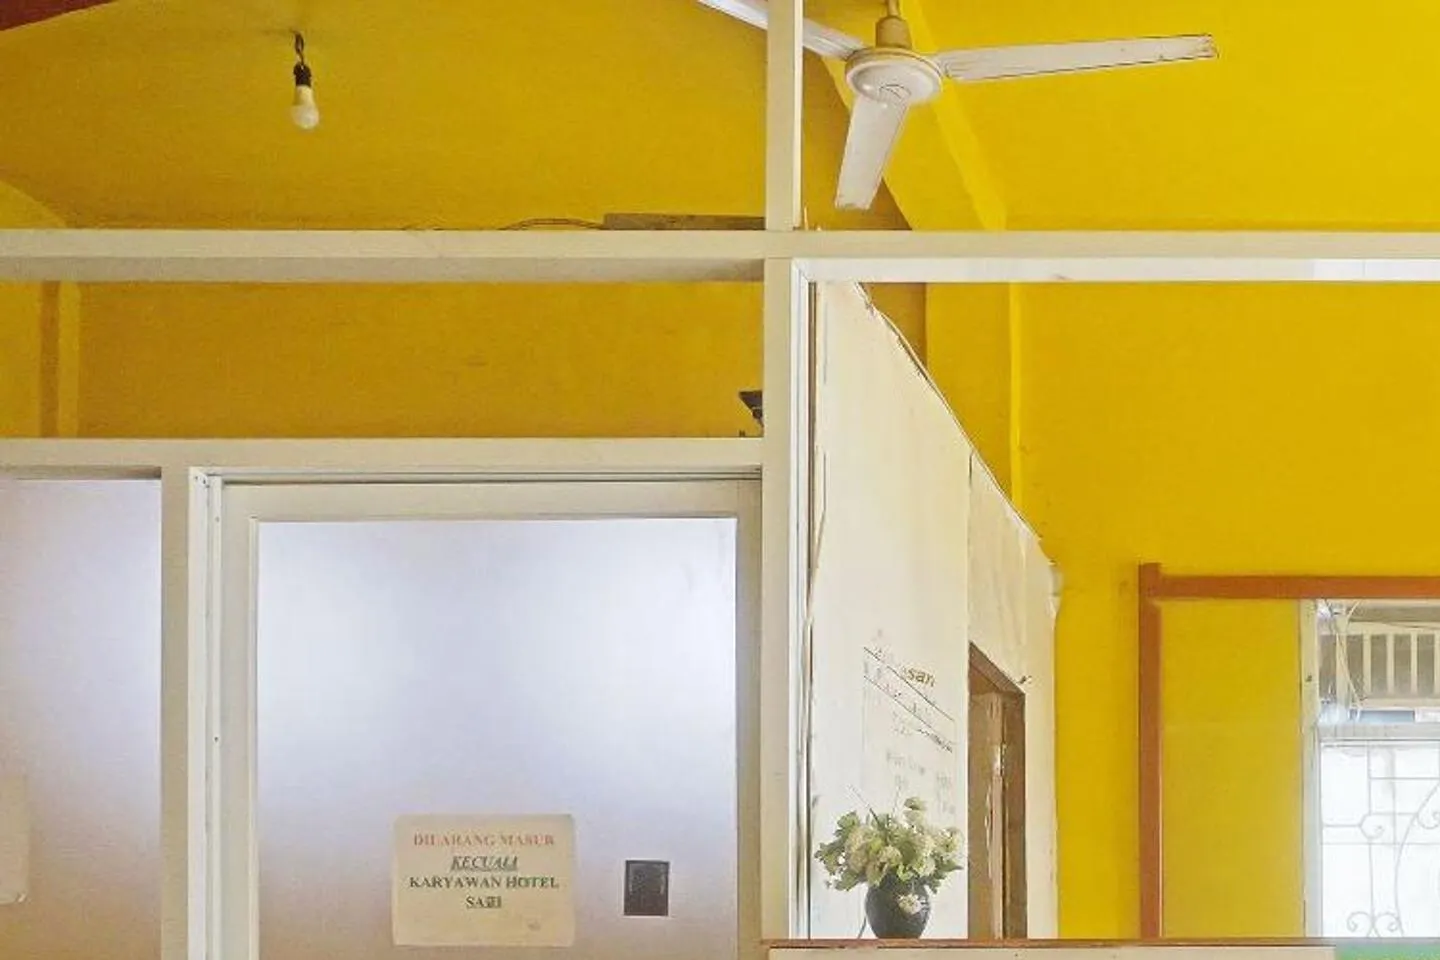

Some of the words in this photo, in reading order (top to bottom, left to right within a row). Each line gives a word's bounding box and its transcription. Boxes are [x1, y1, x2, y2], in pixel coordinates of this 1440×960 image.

[413, 832, 497, 847] DILARANG
[500, 832, 555, 847] MASUK
[450, 855, 519, 872] KECUALI
[409, 876, 502, 889] KARYAWAN
[505, 876, 560, 889] HOTEL
